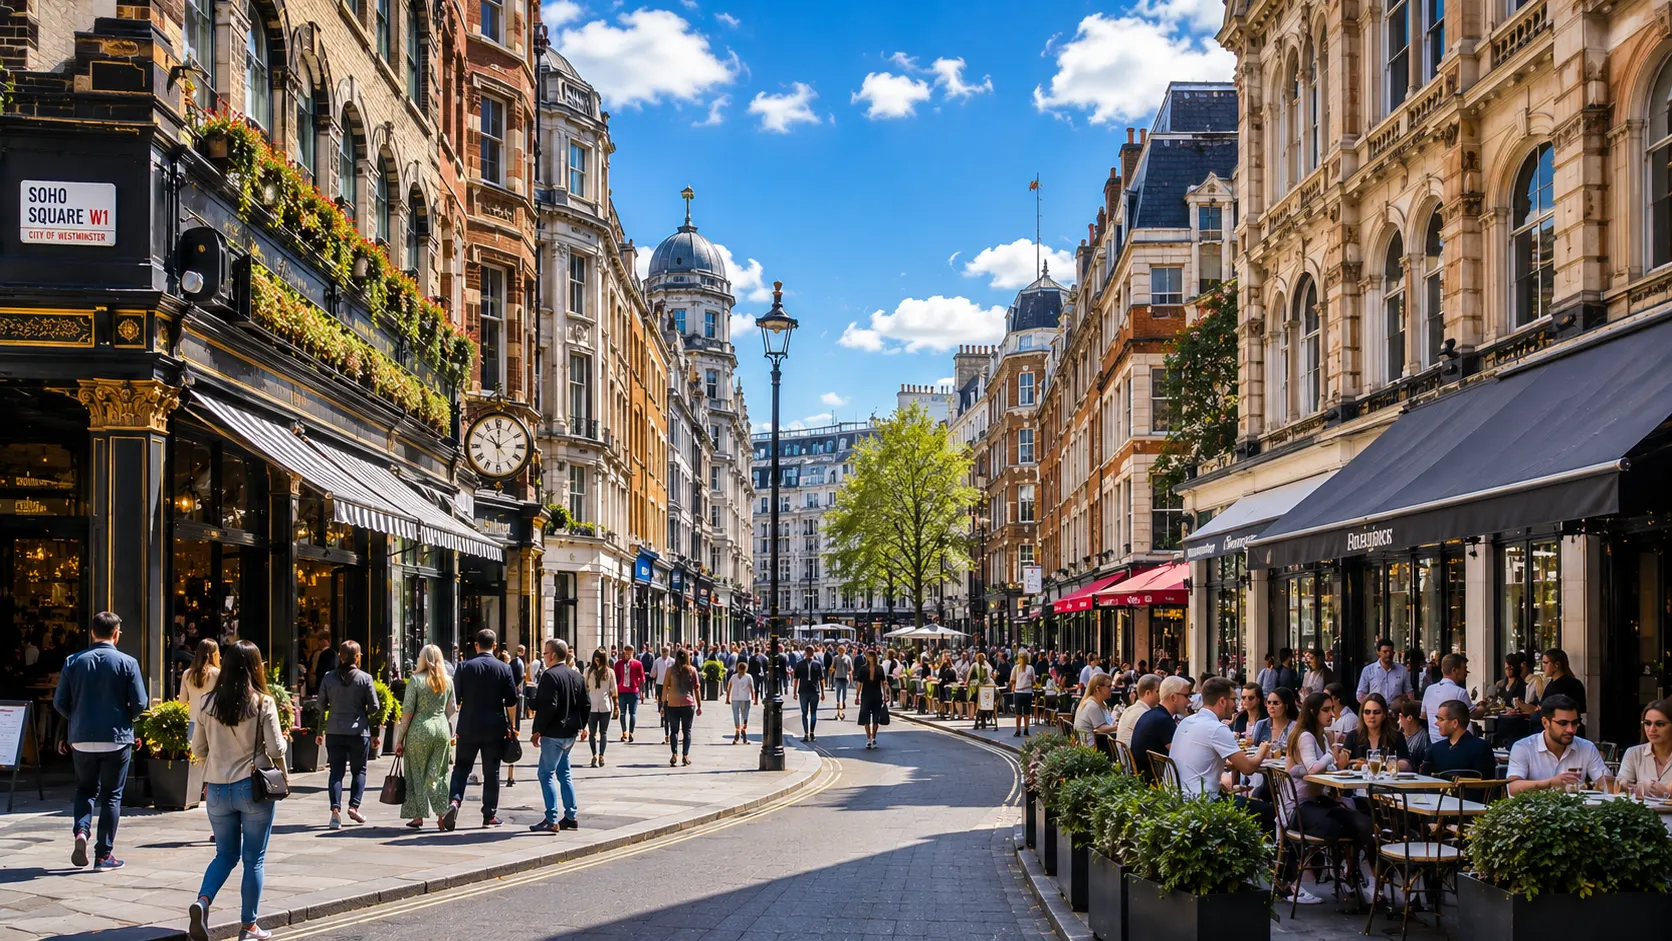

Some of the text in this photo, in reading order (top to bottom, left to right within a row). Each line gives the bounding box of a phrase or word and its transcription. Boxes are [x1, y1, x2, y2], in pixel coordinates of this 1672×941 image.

[29, 187, 67, 204] SOHO
[29, 207, 108, 225] SQUARE W1
[29, 231, 106, 241] CITY OF WESTMINSTER
